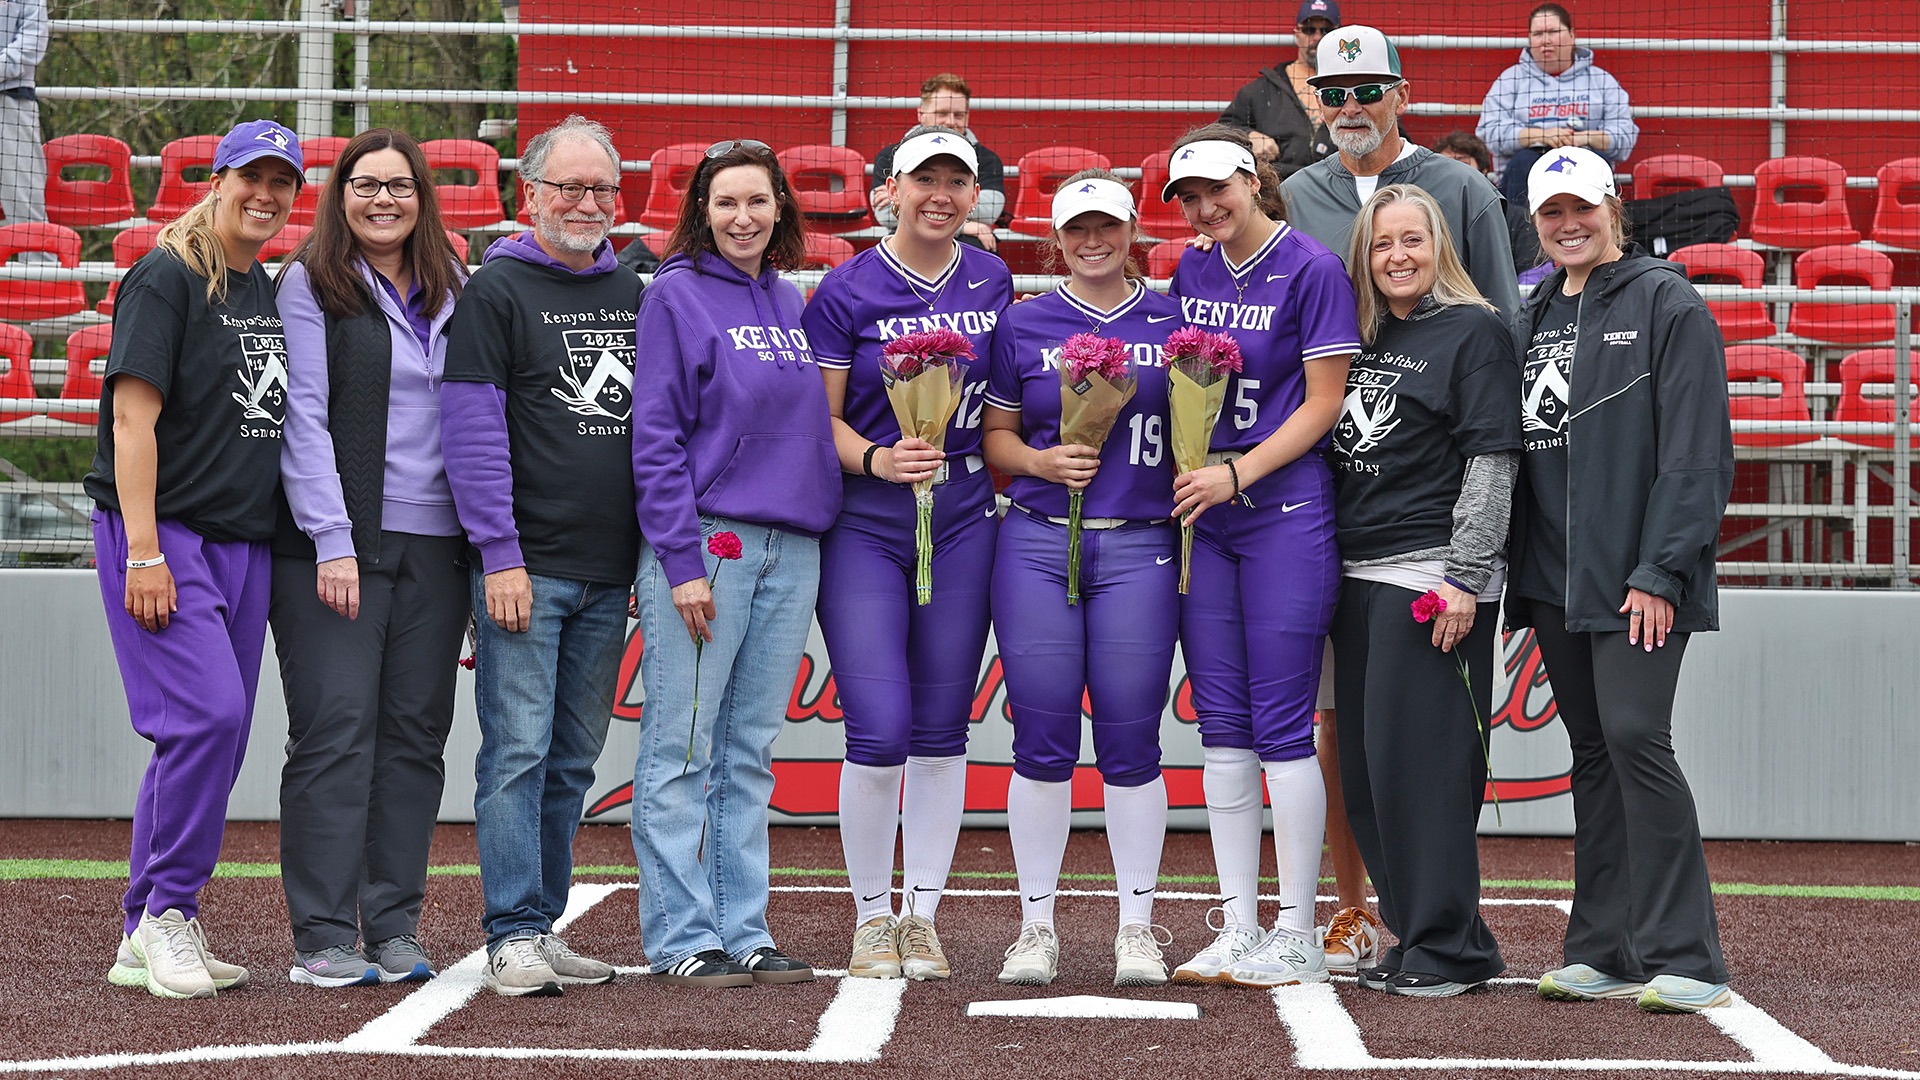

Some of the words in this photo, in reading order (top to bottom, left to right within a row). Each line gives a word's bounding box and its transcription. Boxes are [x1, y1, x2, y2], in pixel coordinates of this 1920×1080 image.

[1529, 103, 1588, 118] SOFTBALL
[255, 315, 283, 328] Softb
[541, 311, 596, 326] Kenyon
[599, 308, 637, 322] Softb
[1180, 295, 1277, 331] KENYON
[876, 310, 998, 341] KENYON
[253, 338, 284, 350] 2025
[581, 333, 627, 346] 2025
[726, 325, 813, 350] KENYO
[1603, 330, 1639, 342] KENYON
[572, 354, 593, 368] #12
[757, 350, 814, 364] SOTBLL
[1380, 352, 1429, 374] Softball
[1349, 371, 1384, 385] 2025
[266, 388, 282, 406] #5
[602, 384, 623, 403] #5
[954, 380, 988, 429] 12
[1233, 378, 1261, 430] 5
[577, 421, 627, 435] Senior
[1339, 421, 1355, 439] #5
[1128, 413, 1164, 467] 19
[1354, 459, 1380, 477] Day
